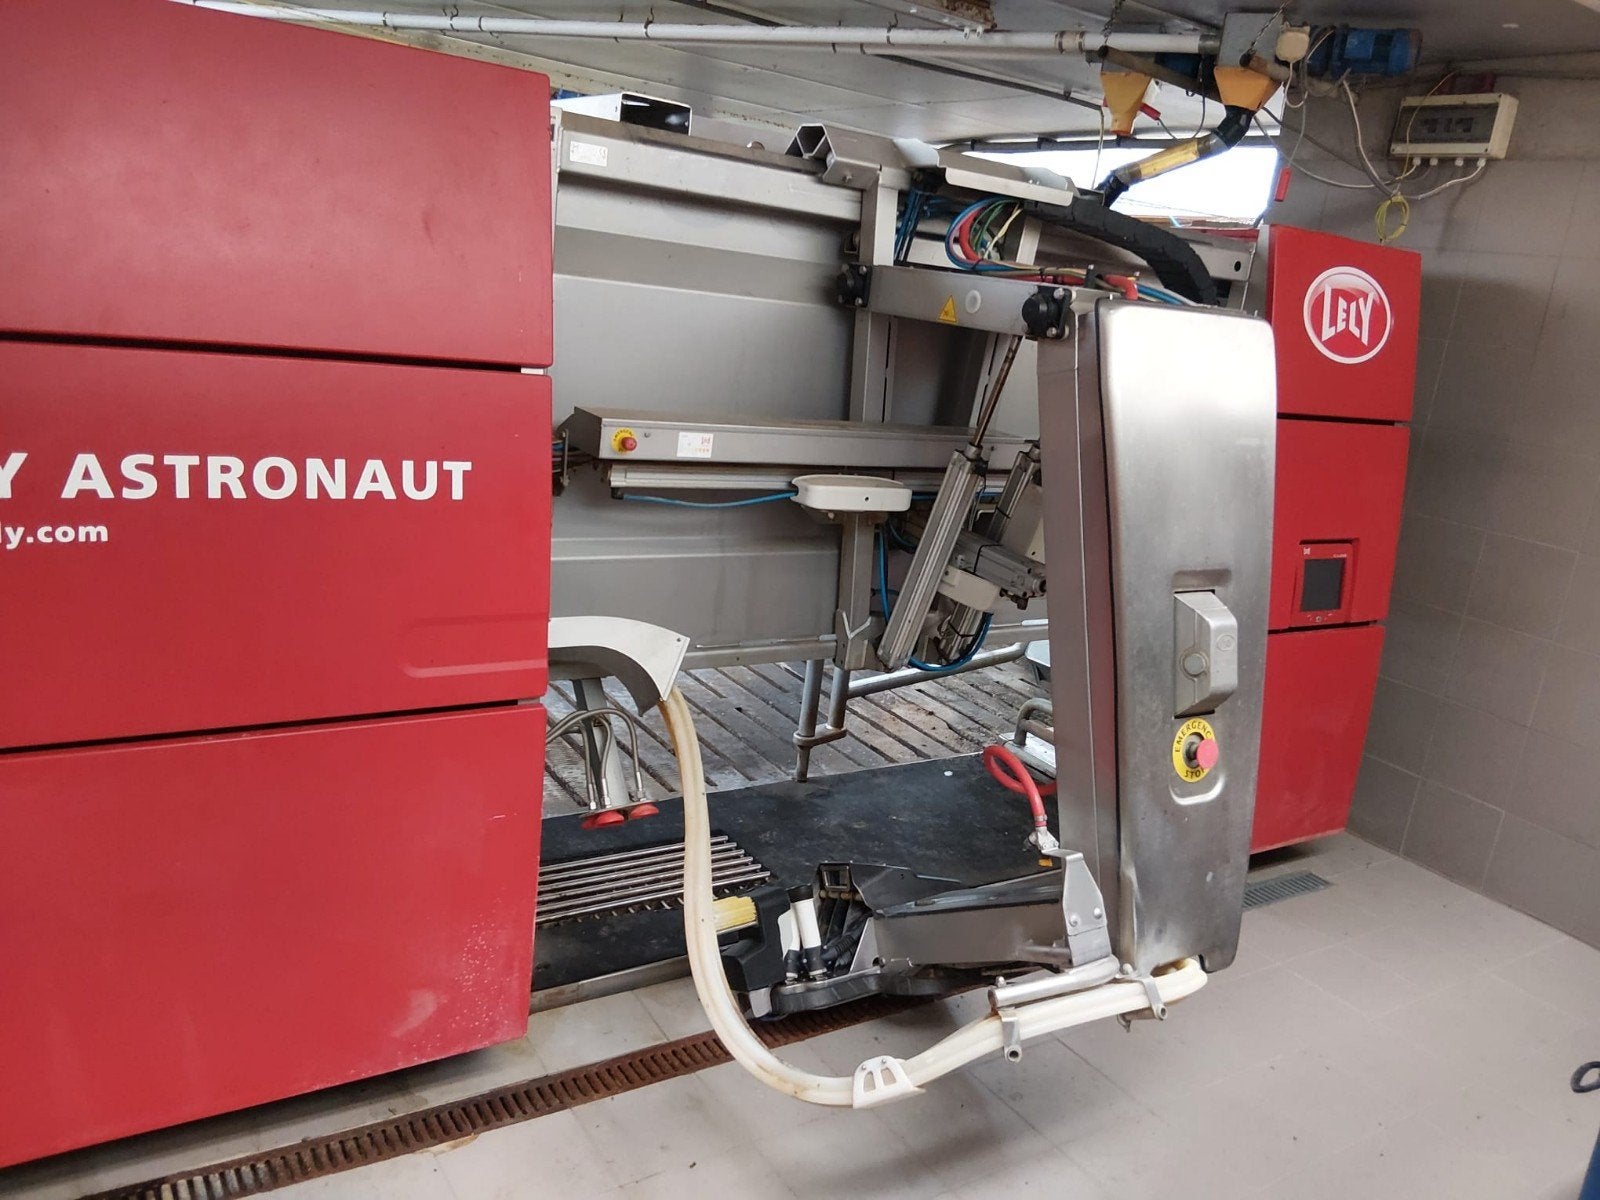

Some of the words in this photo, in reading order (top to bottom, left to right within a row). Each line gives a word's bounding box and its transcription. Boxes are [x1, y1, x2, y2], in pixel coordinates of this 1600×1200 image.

[1321, 283, 1375, 347] LELY
[61, 453, 473, 500] ASTRONAUT
[0, 520, 109, 550] y.com
[1174, 720, 1212, 753] EMERGENC
